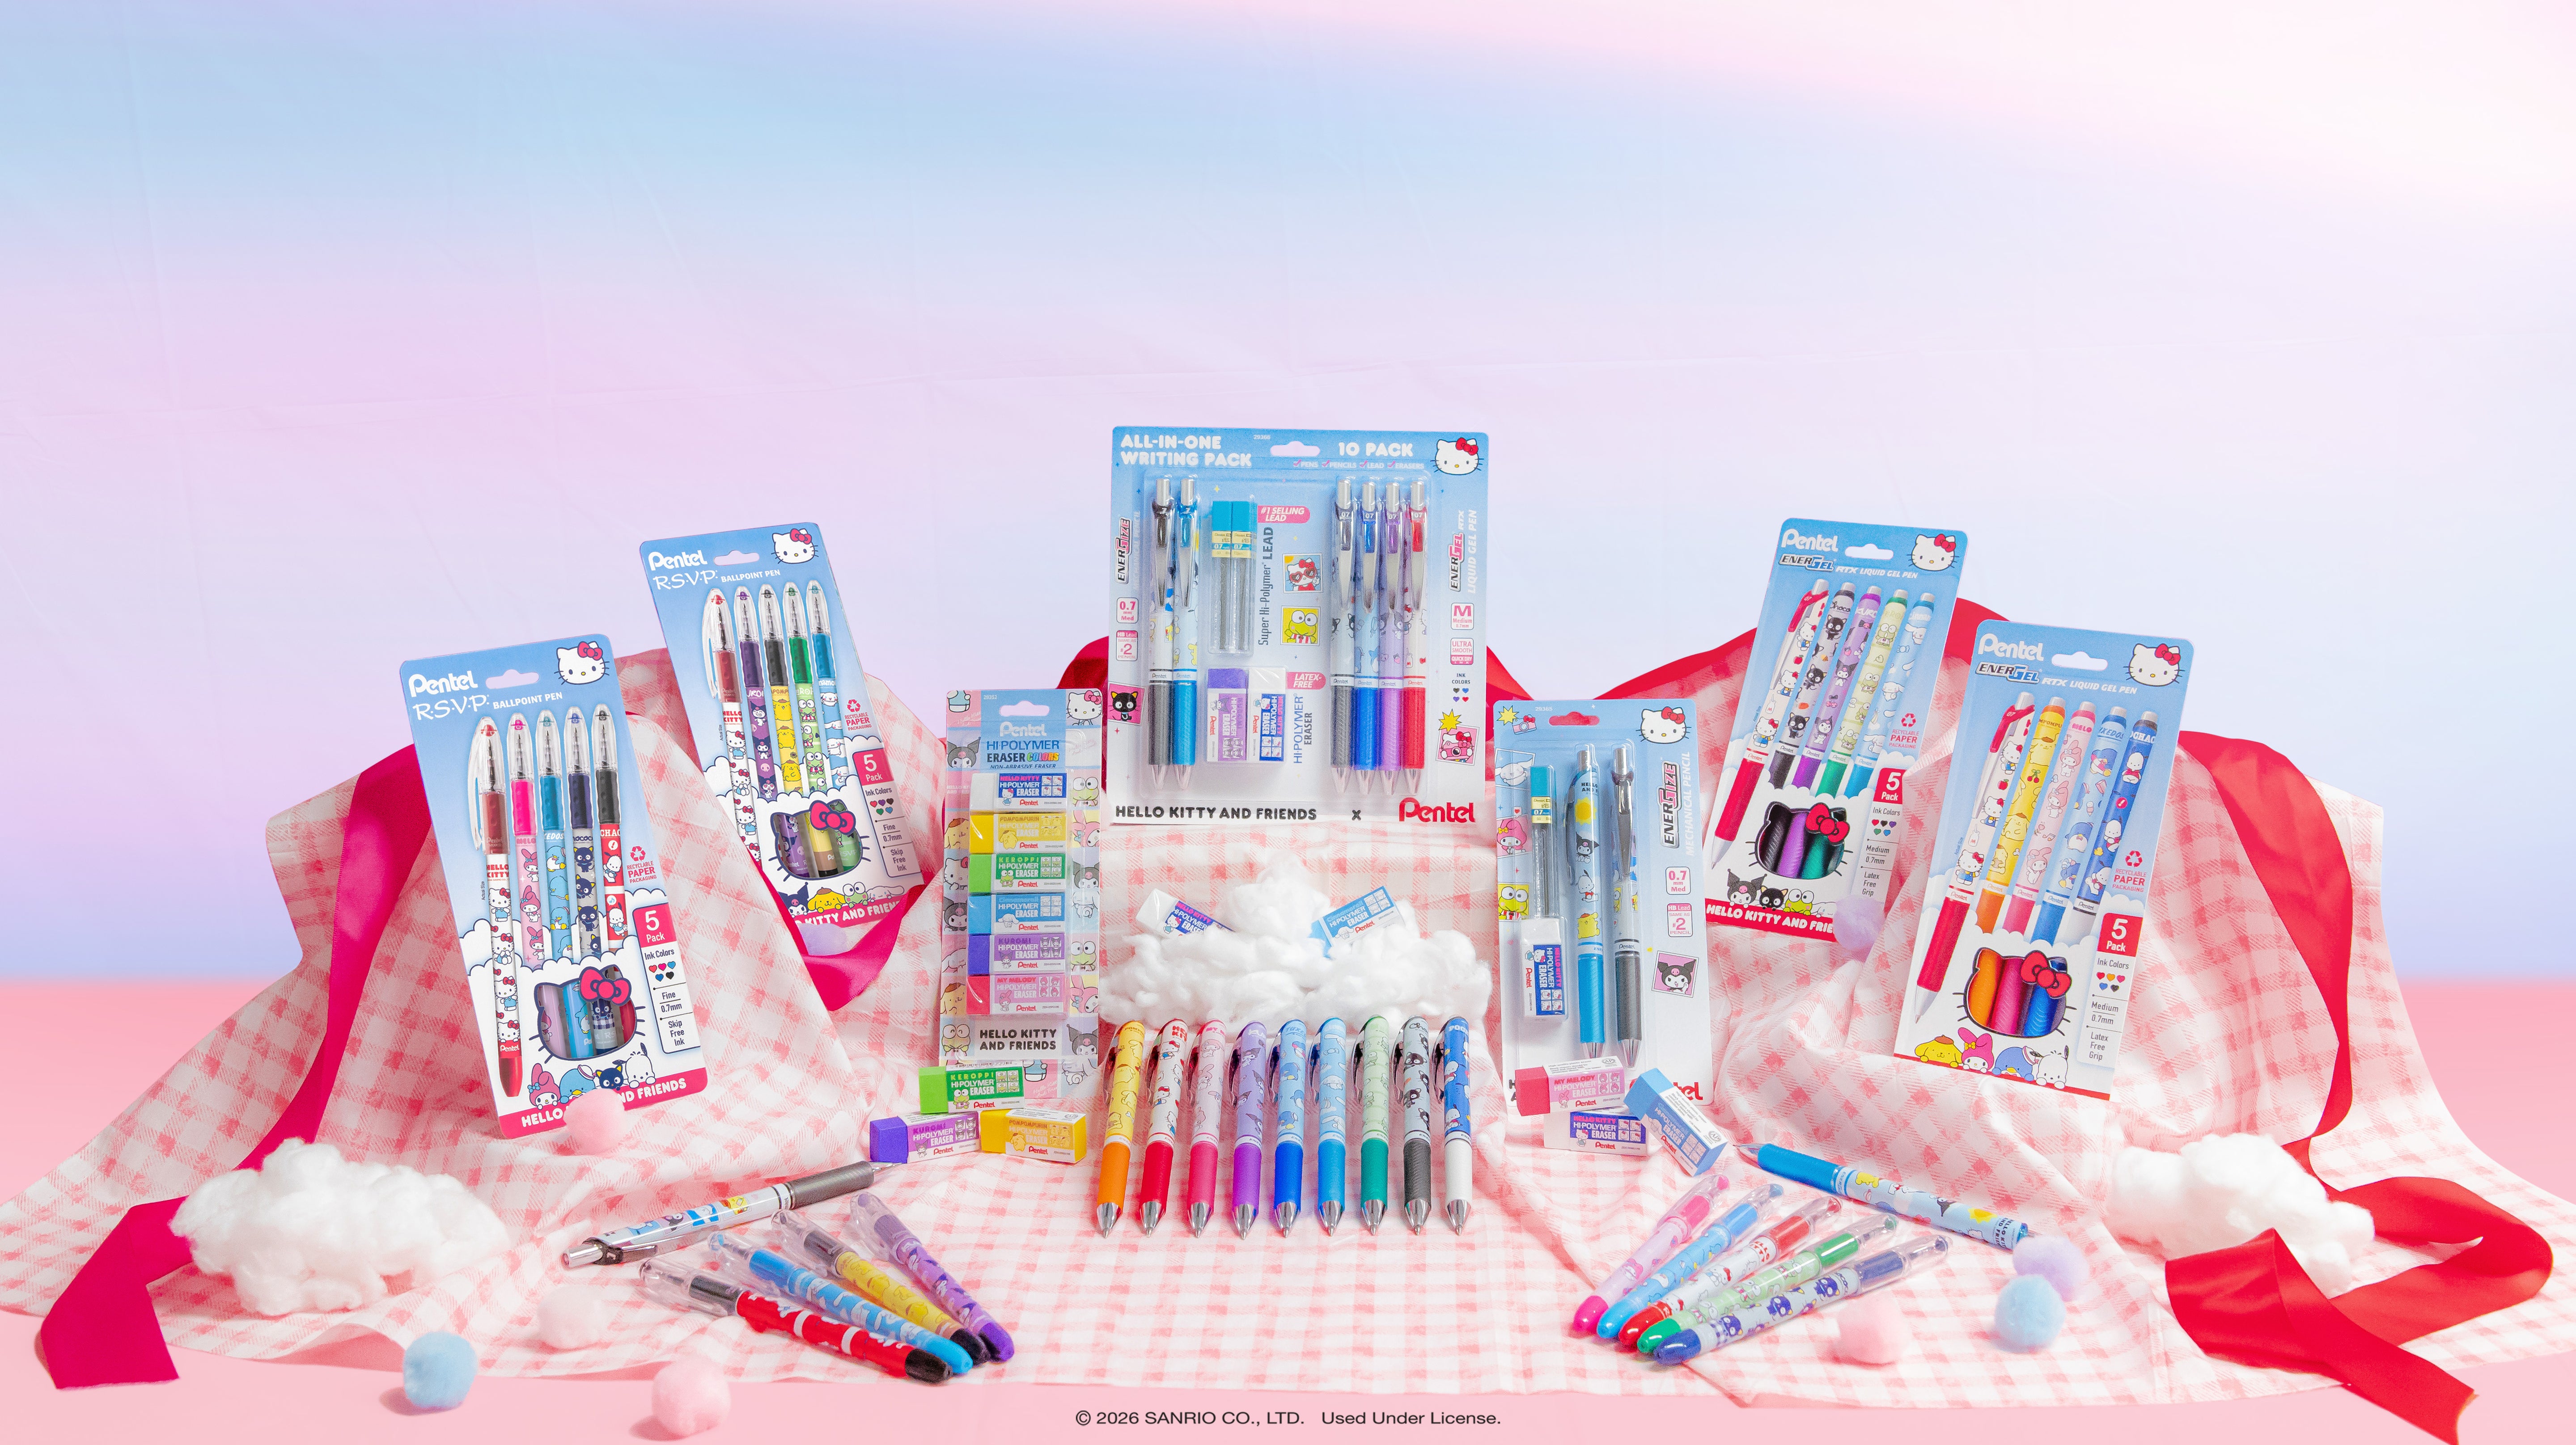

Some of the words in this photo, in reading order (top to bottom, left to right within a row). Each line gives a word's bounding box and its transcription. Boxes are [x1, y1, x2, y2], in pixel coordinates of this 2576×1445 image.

[1121, 434, 1221, 449] ALL-IN-ONE
[1339, 442, 1360, 456] 10
[1366, 443, 1413, 457] PACK
[1120, 451, 1199, 466] WRITING
[1205, 452, 1252, 467] PACK
[1272, 507, 1305, 515] SELLING
[1468, 509, 1477, 531] PEN
[1263, 527, 1273, 560] LEAD
[1468, 534, 1477, 554] GEL
[1781, 528, 1839, 552] Pentel
[648, 550, 708, 570] Pentel
[721, 571, 764, 583] BALLPOINT
[1467, 556, 1478, 594] LIQUID
[1860, 568, 1885, 577] LIQUID
[1120, 601, 1136, 610] 0.7
[1453, 605, 1471, 617] M
[1258, 617, 1272, 645] Super
[1978, 633, 2044, 661] Pentel
[408, 671, 478, 697] Pentel
[2042, 678, 2068, 686] RTX
[2070, 681, 2100, 691] LIQUID
[2101, 684, 2117, 692] GEL
[2119, 686, 2138, 694] PEN
[493, 696, 542, 710] BALLPOINT
[545, 692, 563, 701] PEN
[846, 717, 870, 726] PAPER
[1000, 721, 1047, 737] Pentel
[1304, 713, 1312, 745] ERASER
[1890, 735, 1918, 744] PAPER
[987, 753, 1025, 762] ERASER
[1027, 752, 1060, 762] COLORS
[864, 754, 877, 772] 5
[1682, 751, 1692, 787] PENCIL
[866, 773, 882, 782] Pack
[1886, 772, 1901, 791] 5
[875, 787, 892, 795] Colors
[1881, 791, 1898, 801] Pack
[1115, 806, 1165, 818] HELLO
[1169, 807, 1216, 819] KITTY
[1219, 807, 1251, 819] AND
[1256, 808, 1317, 820] FRIENDS
[1399, 798, 1476, 823] Pentel
[1683, 790, 1695, 856] MECHANICAL
[1866, 845, 1890, 854] Medium
[627, 861, 653, 870] RECYCLABLE
[1865, 857, 1885, 865] 0.7mm
[628, 867, 656, 878] PAPER
[1669, 870, 1687, 880] 0.7
[1864, 871, 1880, 880] Latex
[2116, 868, 2147, 877] RECYCLABLE
[630, 875, 657, 884] PACKAGING
[2114, 875, 2145, 886] PAPER
[1862, 888, 1874, 896] Grip
[2112, 884, 2144, 892] PACKAGING
[2078, 901, 2095, 911] Pentel
[842, 908, 865, 921] AND
[1706, 904, 1743, 919] HELLO
[1745, 910, 1781, 925] KITTY
[1782, 917, 1808, 929] AND
[645, 910, 659, 931] 5
[2111, 918, 2128, 940] 5
[646, 932, 665, 943] Pack
[2106, 940, 2126, 952] Pack
[644, 951, 655, 960] Ink
[656, 949, 674, 958] Colors
[2097, 958, 2107, 966] Ink
[2109, 959, 2129, 969] Colors
[661, 1003, 682, 1013] 0.7mm
[2092, 1001, 2118, 1013] Medium
[668, 1020, 682, 1028] Skip
[2092, 1014, 2114, 1025] 0.7mm
[670, 1030, 684, 1038] Free
[980, 1029, 1017, 1038] HELLO
[1021, 1029, 1057, 1038] KITTY
[2090, 1032, 2109, 1042] Latex
[674, 1038, 685, 1046] Ink
[979, 1041, 1005, 1050] AND
[1009, 1040, 1056, 1050] FRIENDS
[2090, 1042, 2105, 1051] Free
[2089, 1052, 2103, 1061] Grip
[950, 1072, 994, 1081] KEROPPI
[1566, 1075, 1595, 1083] MELODY
[638, 1078, 686, 1099] FRIENDS
[970, 1086, 995, 1095] ERASER
[521, 1108, 563, 1127] HELLO
